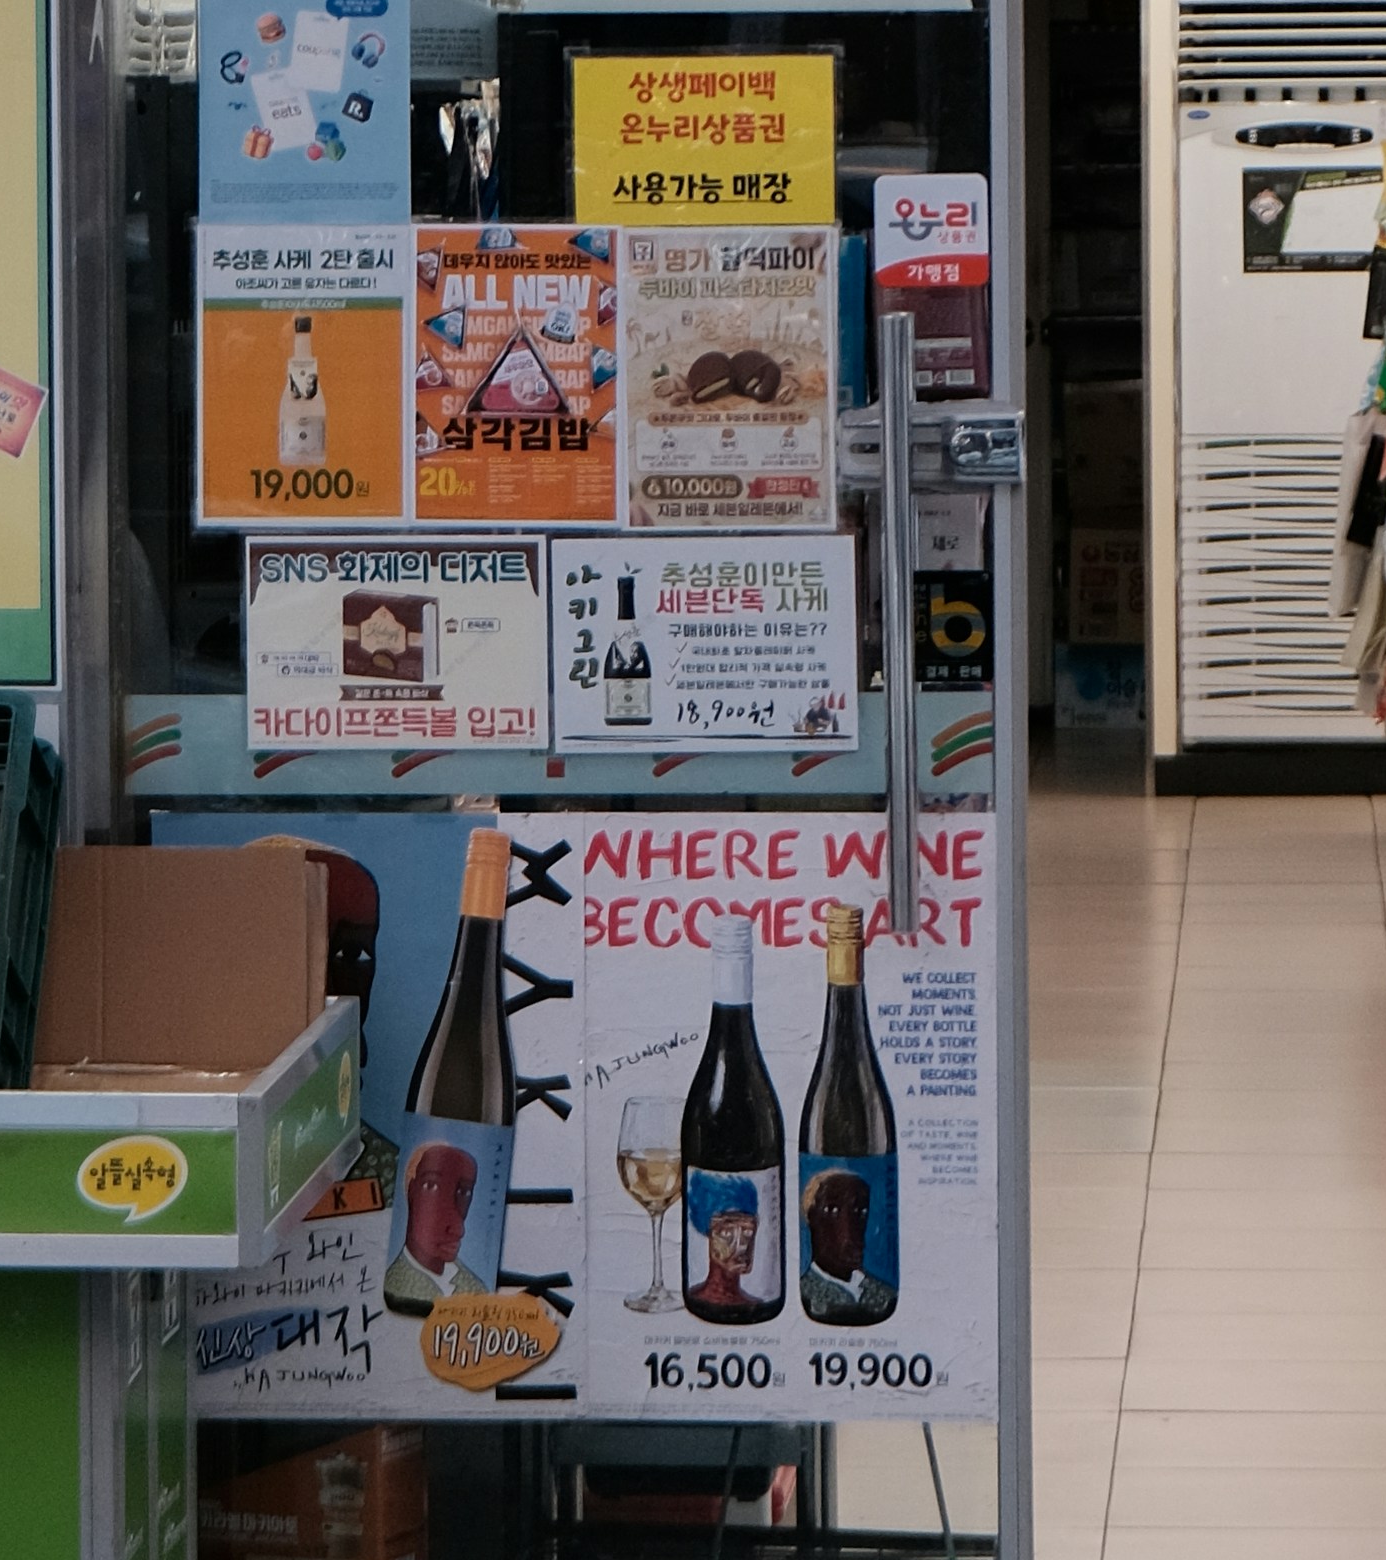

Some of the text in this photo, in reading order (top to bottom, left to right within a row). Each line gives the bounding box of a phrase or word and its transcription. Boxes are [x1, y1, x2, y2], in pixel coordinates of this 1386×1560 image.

[628, 70, 776, 103] 상생페이백
[271, 103, 303, 121] eats
[620, 112, 786, 146] 온누리상품권
[613, 172, 792, 205] 사용가능 매장
[888, 197, 978, 242] 온누리
[212, 248, 395, 271] 추성훈 사케 2탄 출시
[443, 252, 592, 270] 데우지 않아도 맛있는
[664, 246, 711, 272] 명가
[907, 262, 961, 283] 가맹점
[442, 273, 592, 311] ALL NEW
[638, 277, 698, 299] 두바이
[441, 416, 597, 452] 삼각김밥
[249, 468, 370, 502] 19,000원
[657, 501, 804, 518] 지금 바로 세븐일레븐에서!
[259, 550, 529, 584] SNS 화제의 디저트
[660, 561, 825, 588] 추성훈이만든
[655, 586, 829, 615] 세븐단독 사케
[667, 622, 828, 638] 구매해야하는 이유는??
[252, 705, 537, 739] 카다이프쫀득볼 입고!
[676, 698, 775, 730] 18,900원
[823, 829, 986, 881] WNE
[902, 971, 978, 984] WE COLLECT
[877, 1003, 937, 1017] NOT JUST
[888, 1019, 978, 1032] EVERY BOTTLE
[879, 1036, 935, 1049] HOLDS A
[893, 1052, 934, 1065] EVERY
[920, 1068, 978, 1081] BECOMES
[906, 1084, 916, 1097] A
[270, 1303, 384, 1375] 대작
[432, 1323, 545, 1367] 19,900원
[643, 1351, 786, 1392] 16,500원
[808, 1351, 949, 1391] 19,900원
